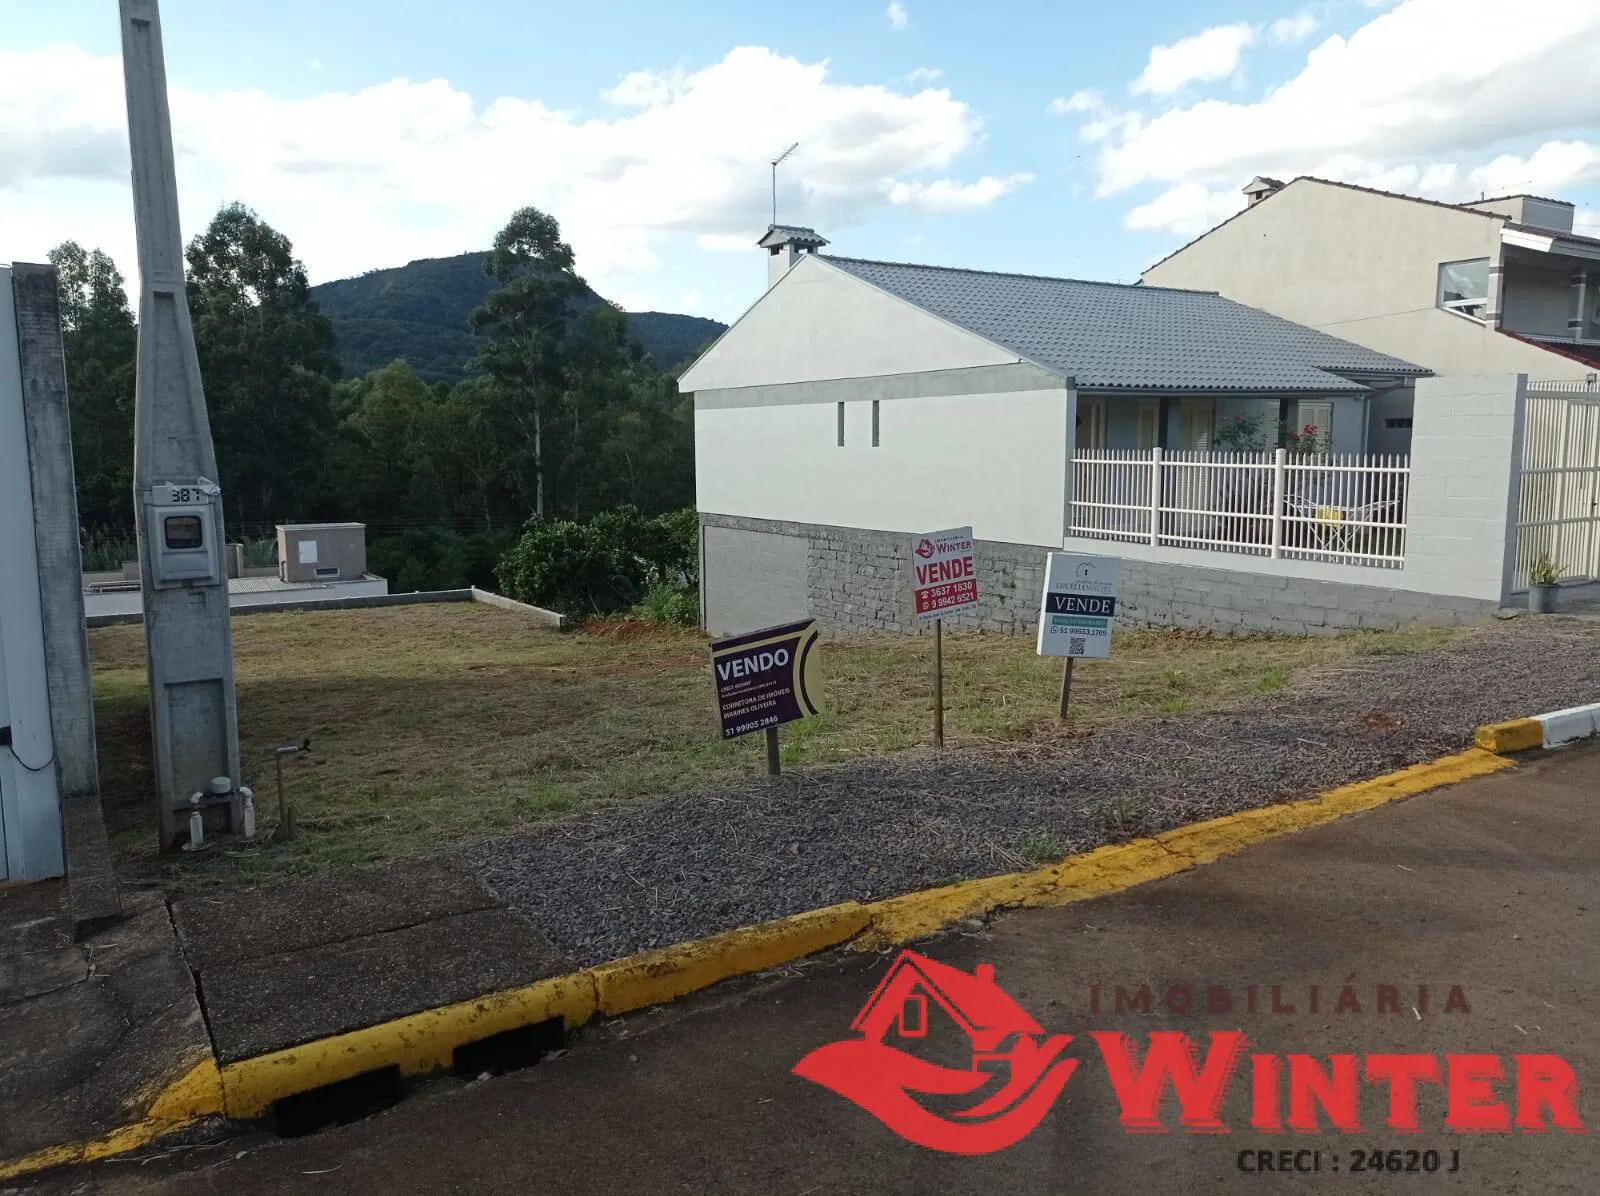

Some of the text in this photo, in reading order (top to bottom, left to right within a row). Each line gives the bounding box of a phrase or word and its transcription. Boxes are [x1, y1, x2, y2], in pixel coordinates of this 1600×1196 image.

[171, 488, 200, 502] 387
[915, 555, 974, 586] VENDE
[930, 586, 951, 598] 3637
[931, 600, 937, 608] 9
[1054, 596, 1111, 613] VENDE
[717, 648, 789, 681] VENDO
[722, 696, 757, 711] CORRETORA
[757, 694, 766, 702] DE
[766, 687, 791, 699] IMÓVEIS
[750, 700, 777, 712] OLIVEIRA
[725, 715, 779, 737] 51 99905 2846
